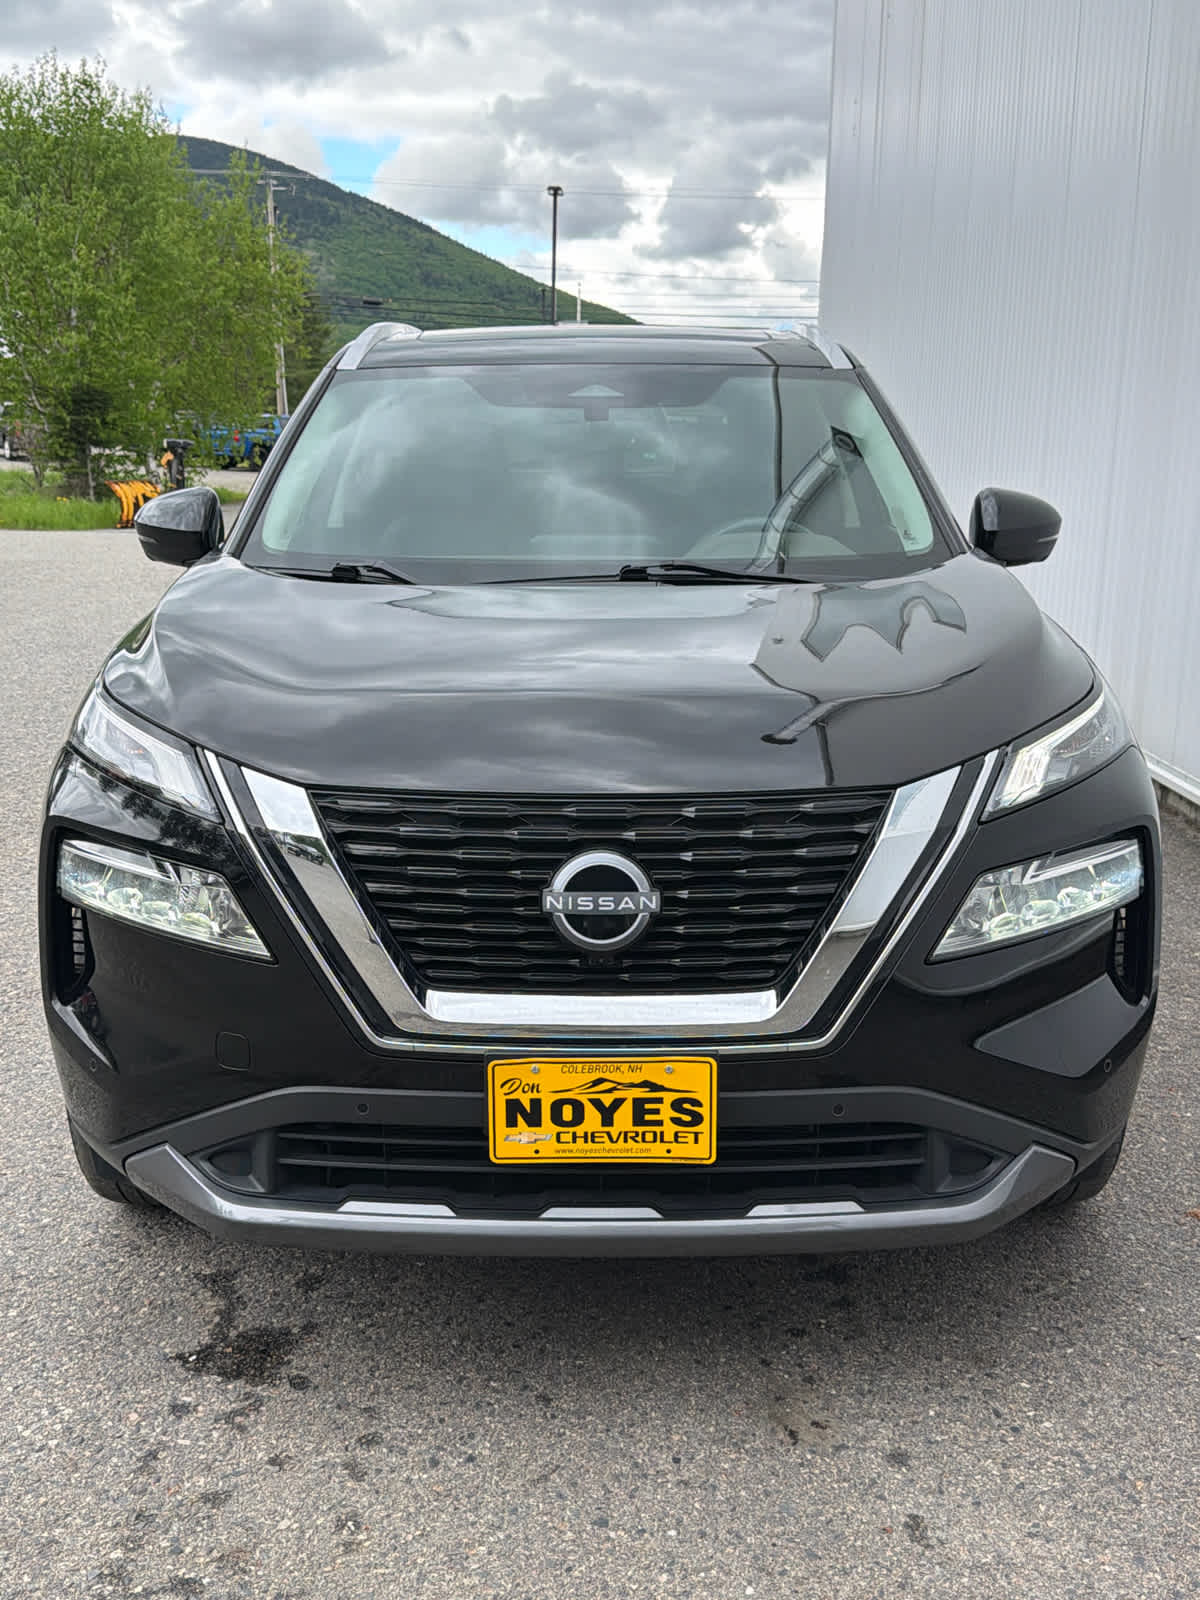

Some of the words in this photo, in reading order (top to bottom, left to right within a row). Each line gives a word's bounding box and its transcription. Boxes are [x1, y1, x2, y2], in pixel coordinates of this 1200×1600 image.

[546, 896, 656, 910] NISSAN
[560, 1064, 625, 1075] COLEBROOK,
[627, 1064, 643, 1074] NH
[500, 1078, 541, 1096] Don
[505, 1097, 704, 1128] NOYES
[556, 1130, 704, 1144] CHEVROLET
[554, 1147, 651, 1155] www.noyeschevrolet.com
